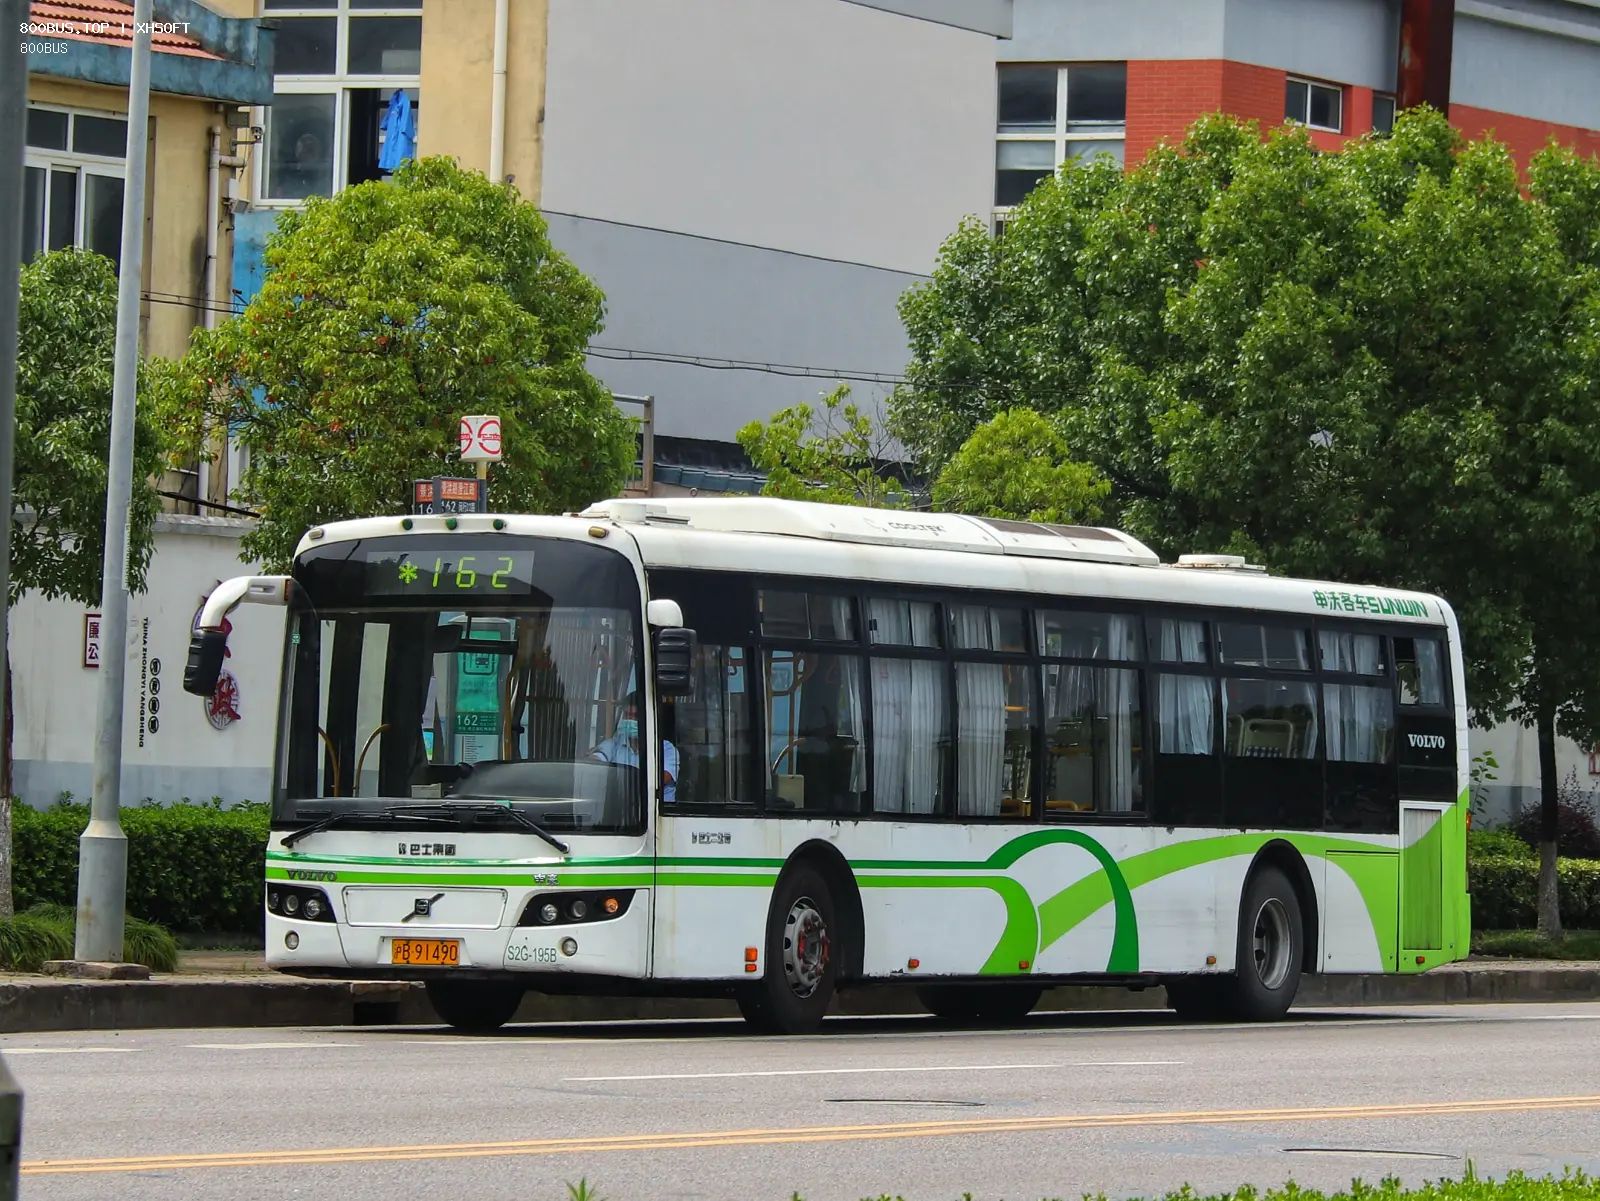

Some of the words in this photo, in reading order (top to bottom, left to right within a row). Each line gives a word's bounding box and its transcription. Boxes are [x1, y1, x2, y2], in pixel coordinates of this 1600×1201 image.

[432, 556, 513, 588] 162
[1312, 589, 1369, 613] 申沃客车
[1366, 597, 1429, 617] SUNWIN
[457, 714, 478, 726] 162
[1407, 734, 1446, 749] VOLVO
[285, 869, 338, 882] VOLVO
[507, 945, 557, 963] S2G-195B
